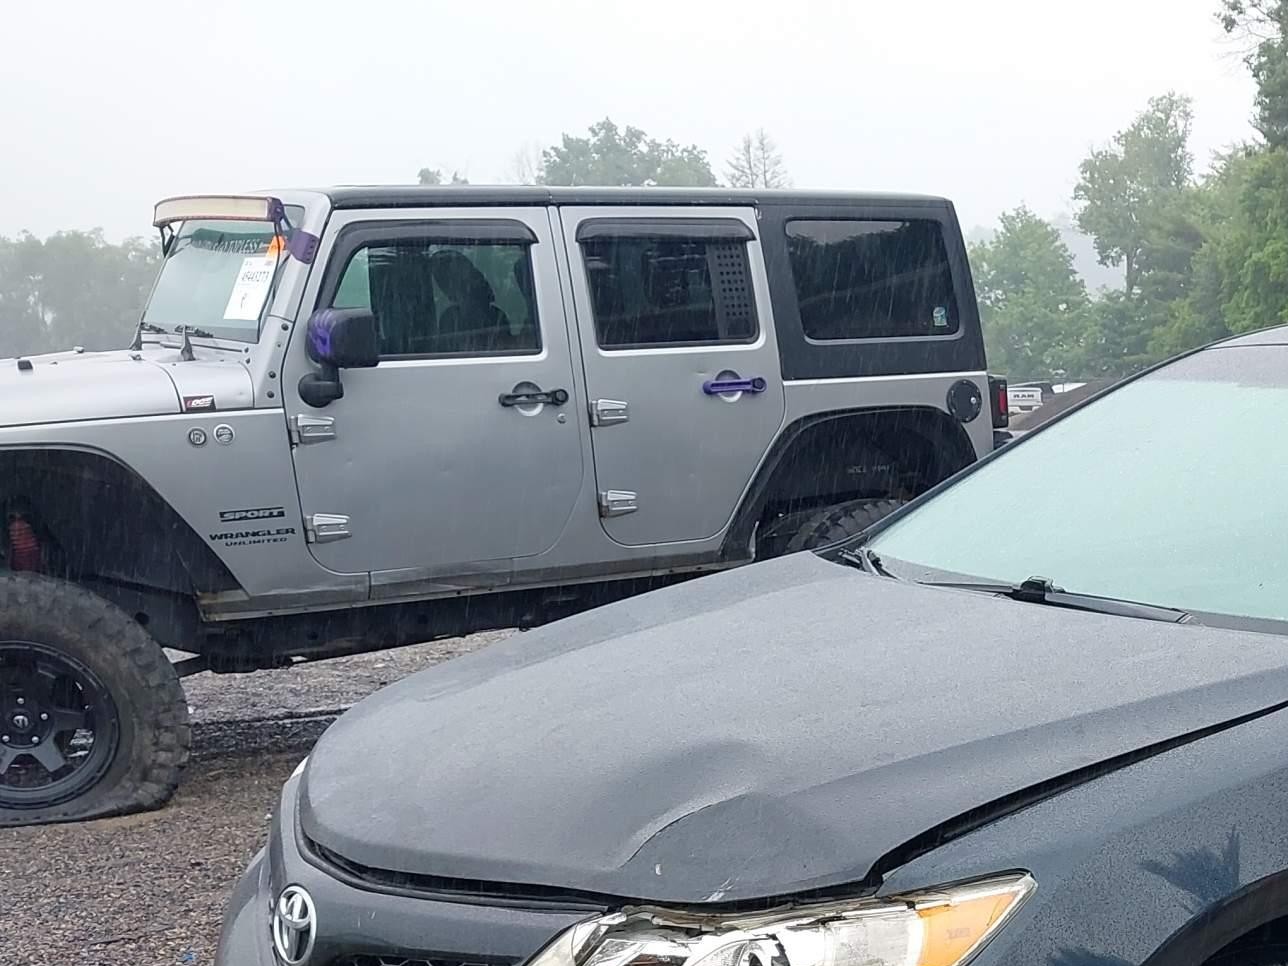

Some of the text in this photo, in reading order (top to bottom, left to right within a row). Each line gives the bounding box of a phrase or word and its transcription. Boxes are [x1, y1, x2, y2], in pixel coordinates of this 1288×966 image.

[222, 508, 282, 520] SPORT
[209, 528, 296, 540] WRANGLER
[225, 538, 287, 546] UNLIMITED
